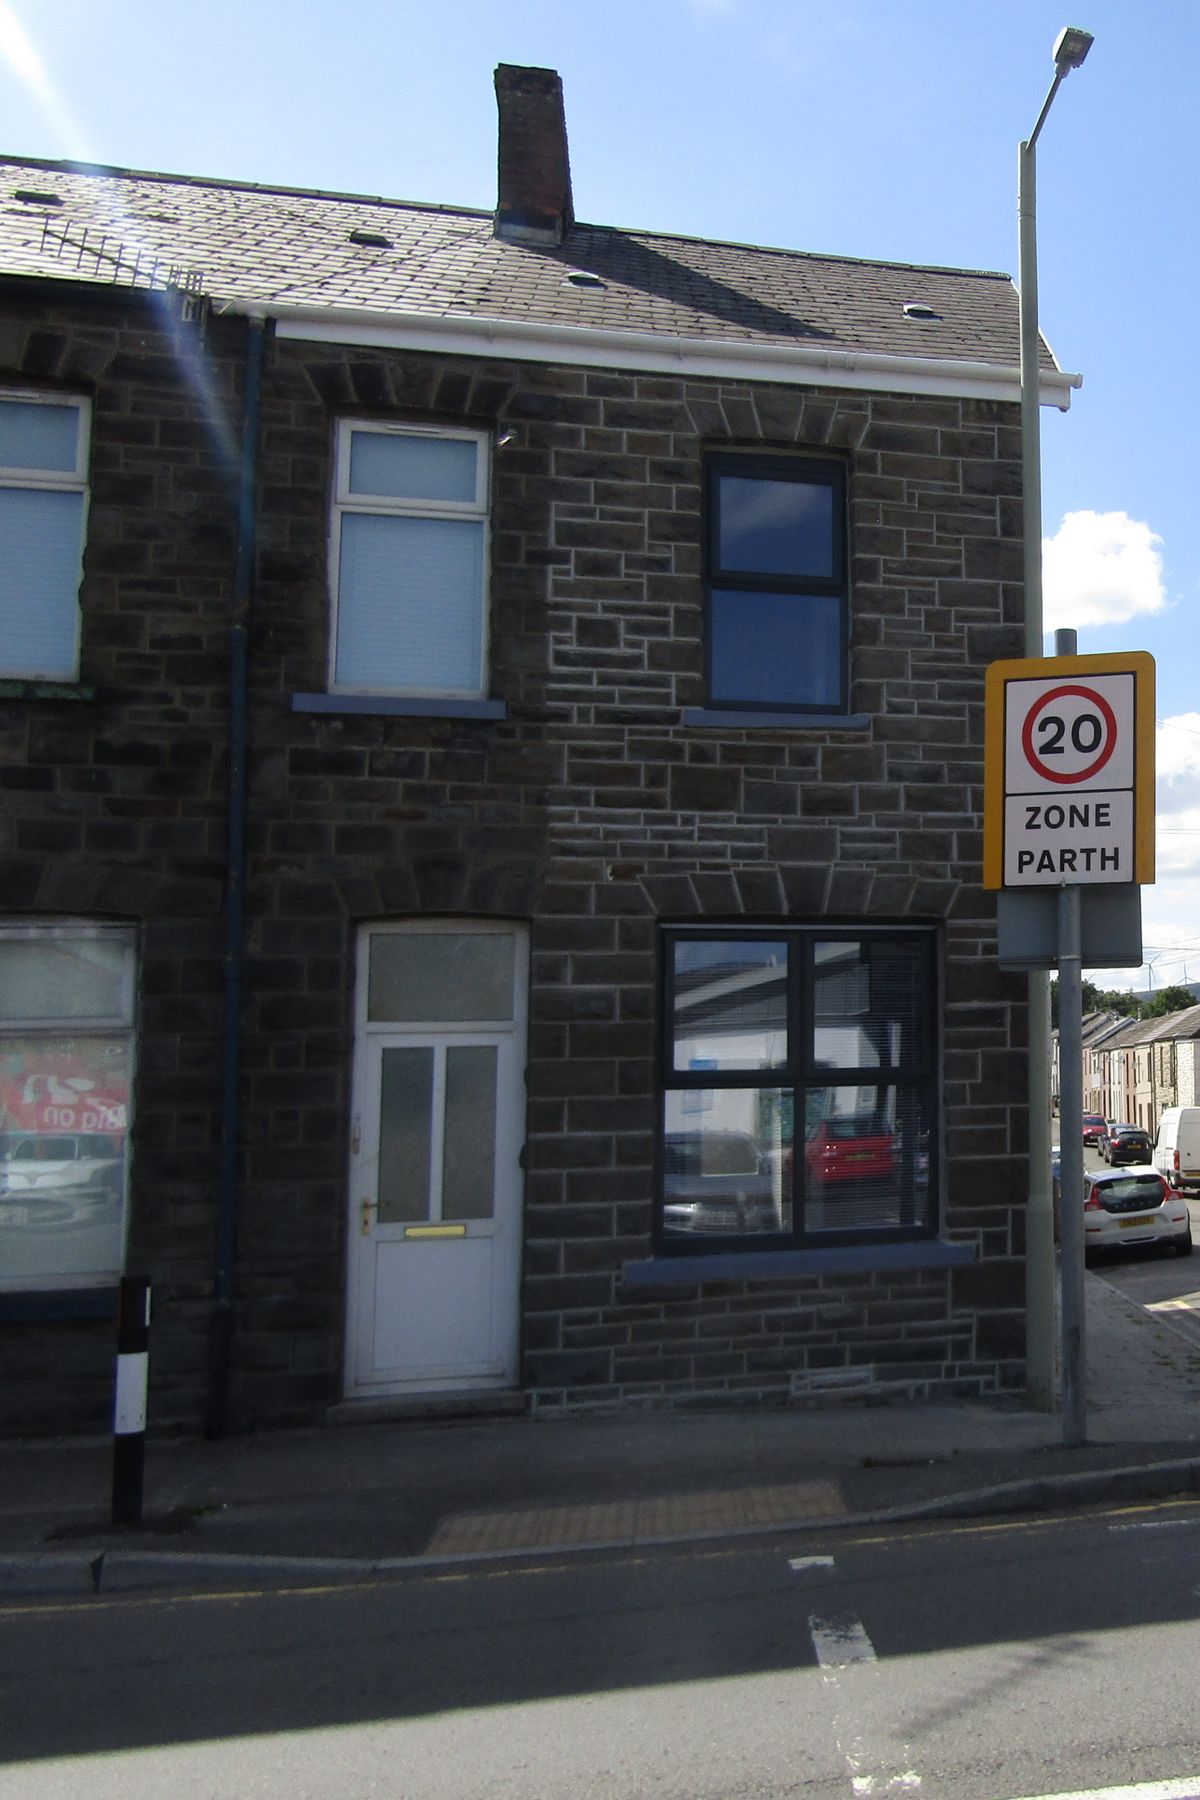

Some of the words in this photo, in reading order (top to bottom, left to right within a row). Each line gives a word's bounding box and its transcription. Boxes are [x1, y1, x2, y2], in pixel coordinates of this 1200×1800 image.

[1037, 714, 1102, 755] 20
[1025, 804, 1111, 830] ZONE
[1017, 847, 1119, 874] PARTH
